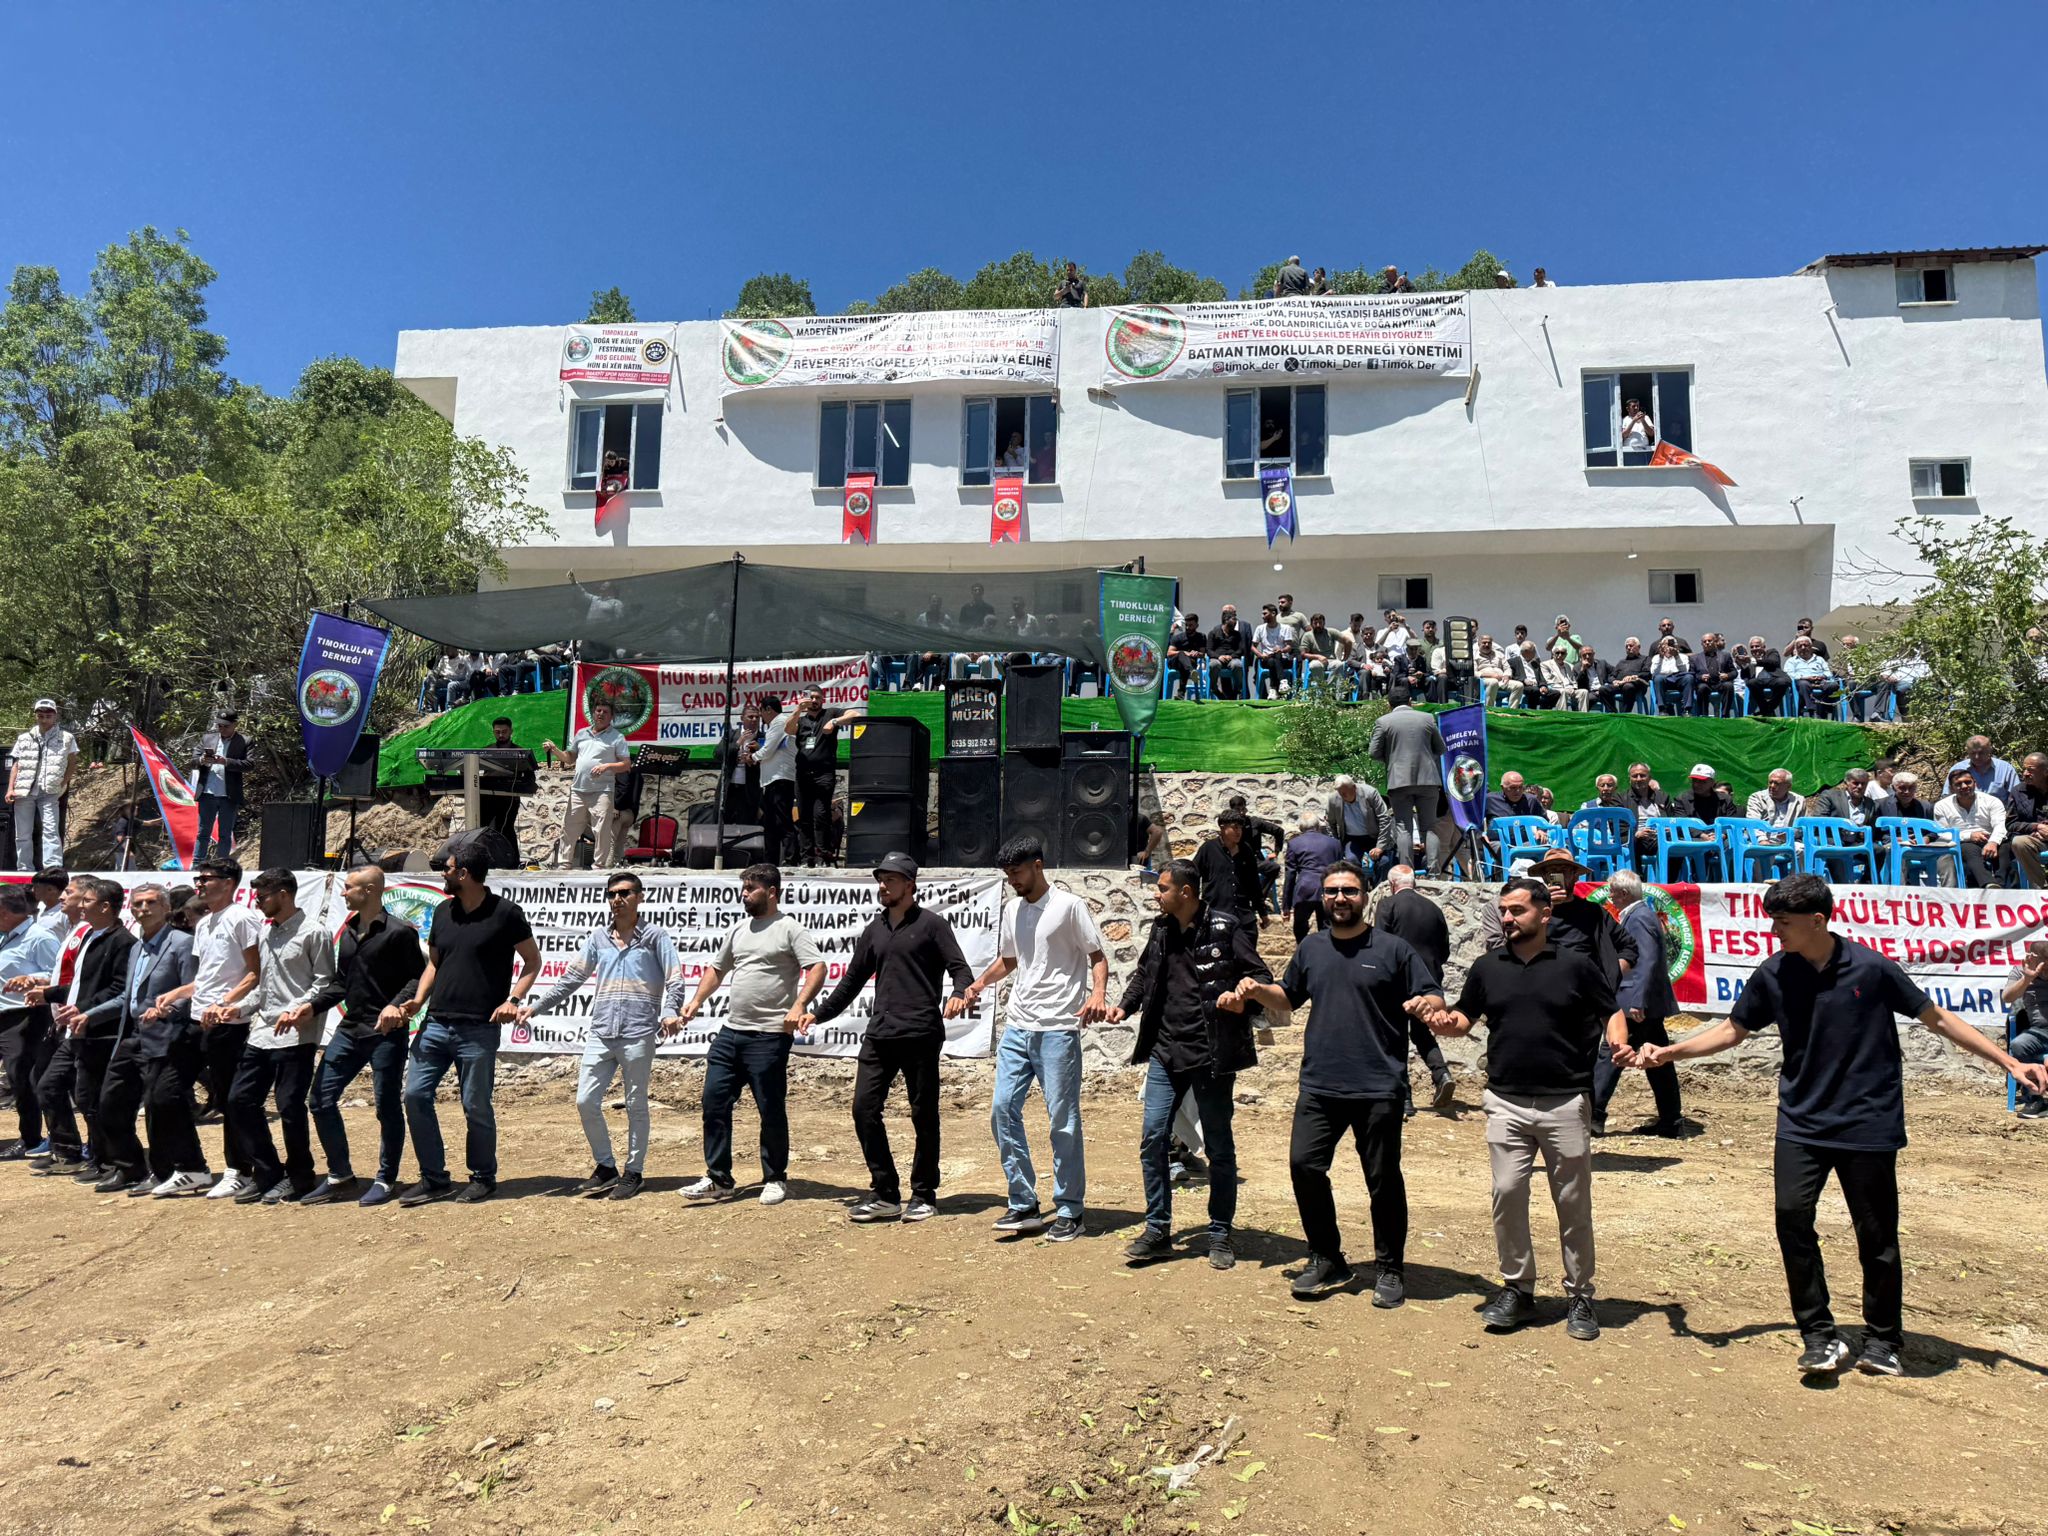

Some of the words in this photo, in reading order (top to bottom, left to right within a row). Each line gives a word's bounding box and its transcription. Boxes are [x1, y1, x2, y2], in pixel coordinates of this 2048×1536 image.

[1288, 310, 1328, 319] FUHUŞA,
[1329, 310, 1371, 320] YASADIŞI
[1373, 306, 1400, 317] BAHİS
[796, 325, 838, 336] MADEYÊN
[1217, 331, 1230, 339] EN
[1231, 329, 1249, 338] NET
[1252, 329, 1264, 338] VE
[1266, 329, 1278, 337] EN
[1382, 329, 1423, 339] DİYORUZ
[593, 337, 610, 345] DOĞA
[621, 337, 644, 345] KÜLTÜR
[598, 345, 637, 353] FESTİVALİNE
[1188, 346, 1243, 360] BATMAN
[1246, 344, 1334, 357] TIMOKLULAR
[1337, 343, 1395, 355] DERNEĞİ
[1398, 342, 1463, 358] YÖNETİMİ
[1225, 360, 1279, 372] timok_der
[1300, 359, 1362, 370] Timoki_Der
[1381, 359, 1414, 370] Timok
[1417, 360, 1436, 370] Der
[1110, 599, 1165, 612] TIMOKLULAR
[1118, 613, 1156, 624] DERNEĞİ
[316, 637, 375, 657] TIMOKLULAR
[322, 650, 362, 665] DERNEĞİ
[751, 667, 799, 683] HATIN
[681, 692, 727, 713] ÇAND
[951, 687, 997, 708] MERETO
[660, 722, 728, 738] KOMELEY
[951, 739, 966, 747] 0535
[979, 738, 988, 746] 52
[501, 882, 578, 904] DIJMINÊN
[641, 887, 674, 904] EZIN
[677, 882, 687, 904] Ê
[798, 883, 809, 905] Û
[811, 888, 873, 905] JIYANA
[1831, 892, 1947, 928] KÜLTÜR
[1949, 903, 1991, 930] VE
